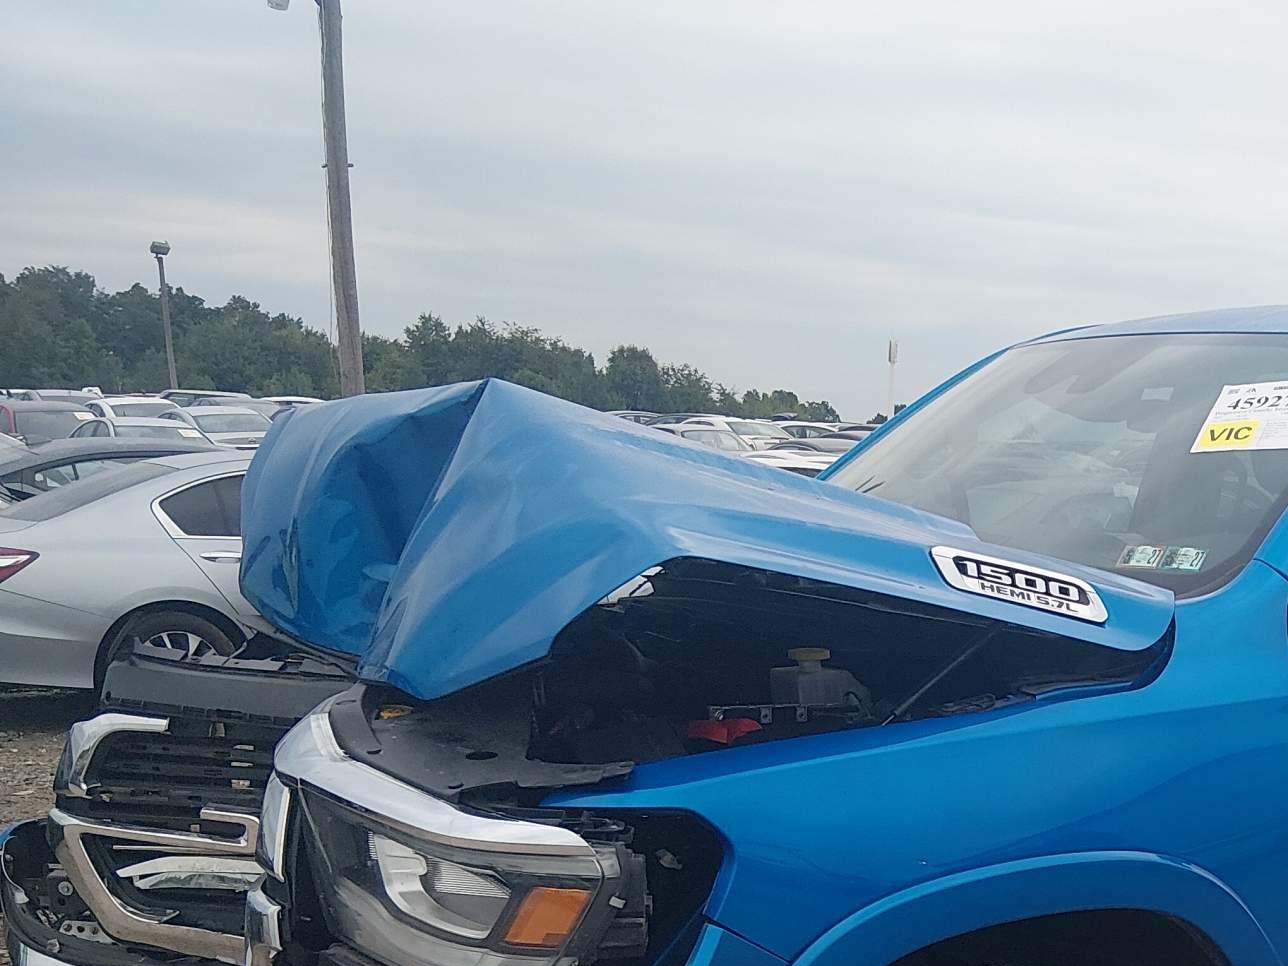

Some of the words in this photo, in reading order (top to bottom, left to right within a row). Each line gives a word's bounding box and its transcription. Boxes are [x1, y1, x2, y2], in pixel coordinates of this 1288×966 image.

[1209, 426, 1253, 442] VIC
[958, 560, 1081, 601] 1500
[980, 582, 1032, 601] HEMI
[1036, 596, 1079, 613] 5.7L
